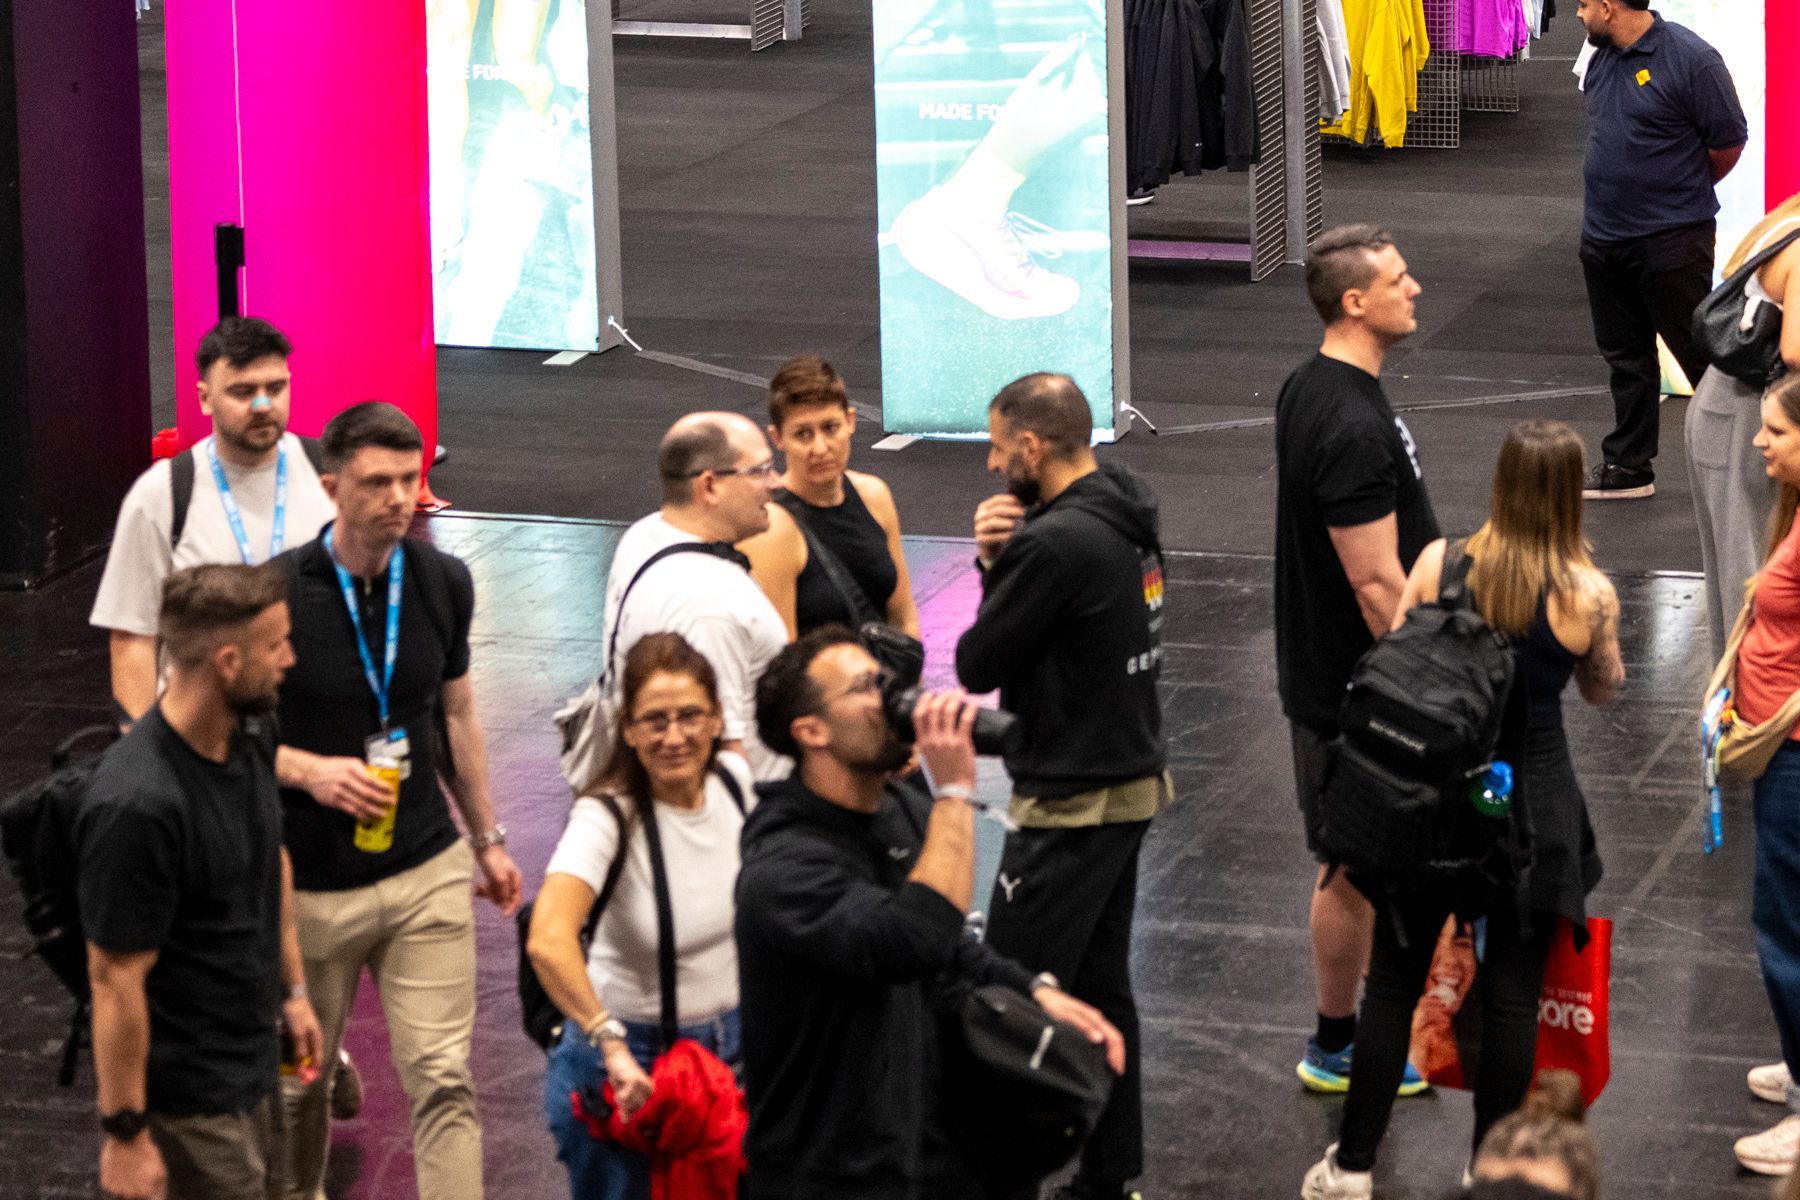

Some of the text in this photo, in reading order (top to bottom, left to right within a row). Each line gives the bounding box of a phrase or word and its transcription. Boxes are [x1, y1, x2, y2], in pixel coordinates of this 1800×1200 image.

[919, 102, 1002, 121] MADE FO
[1538, 997, 1595, 1036] ore
